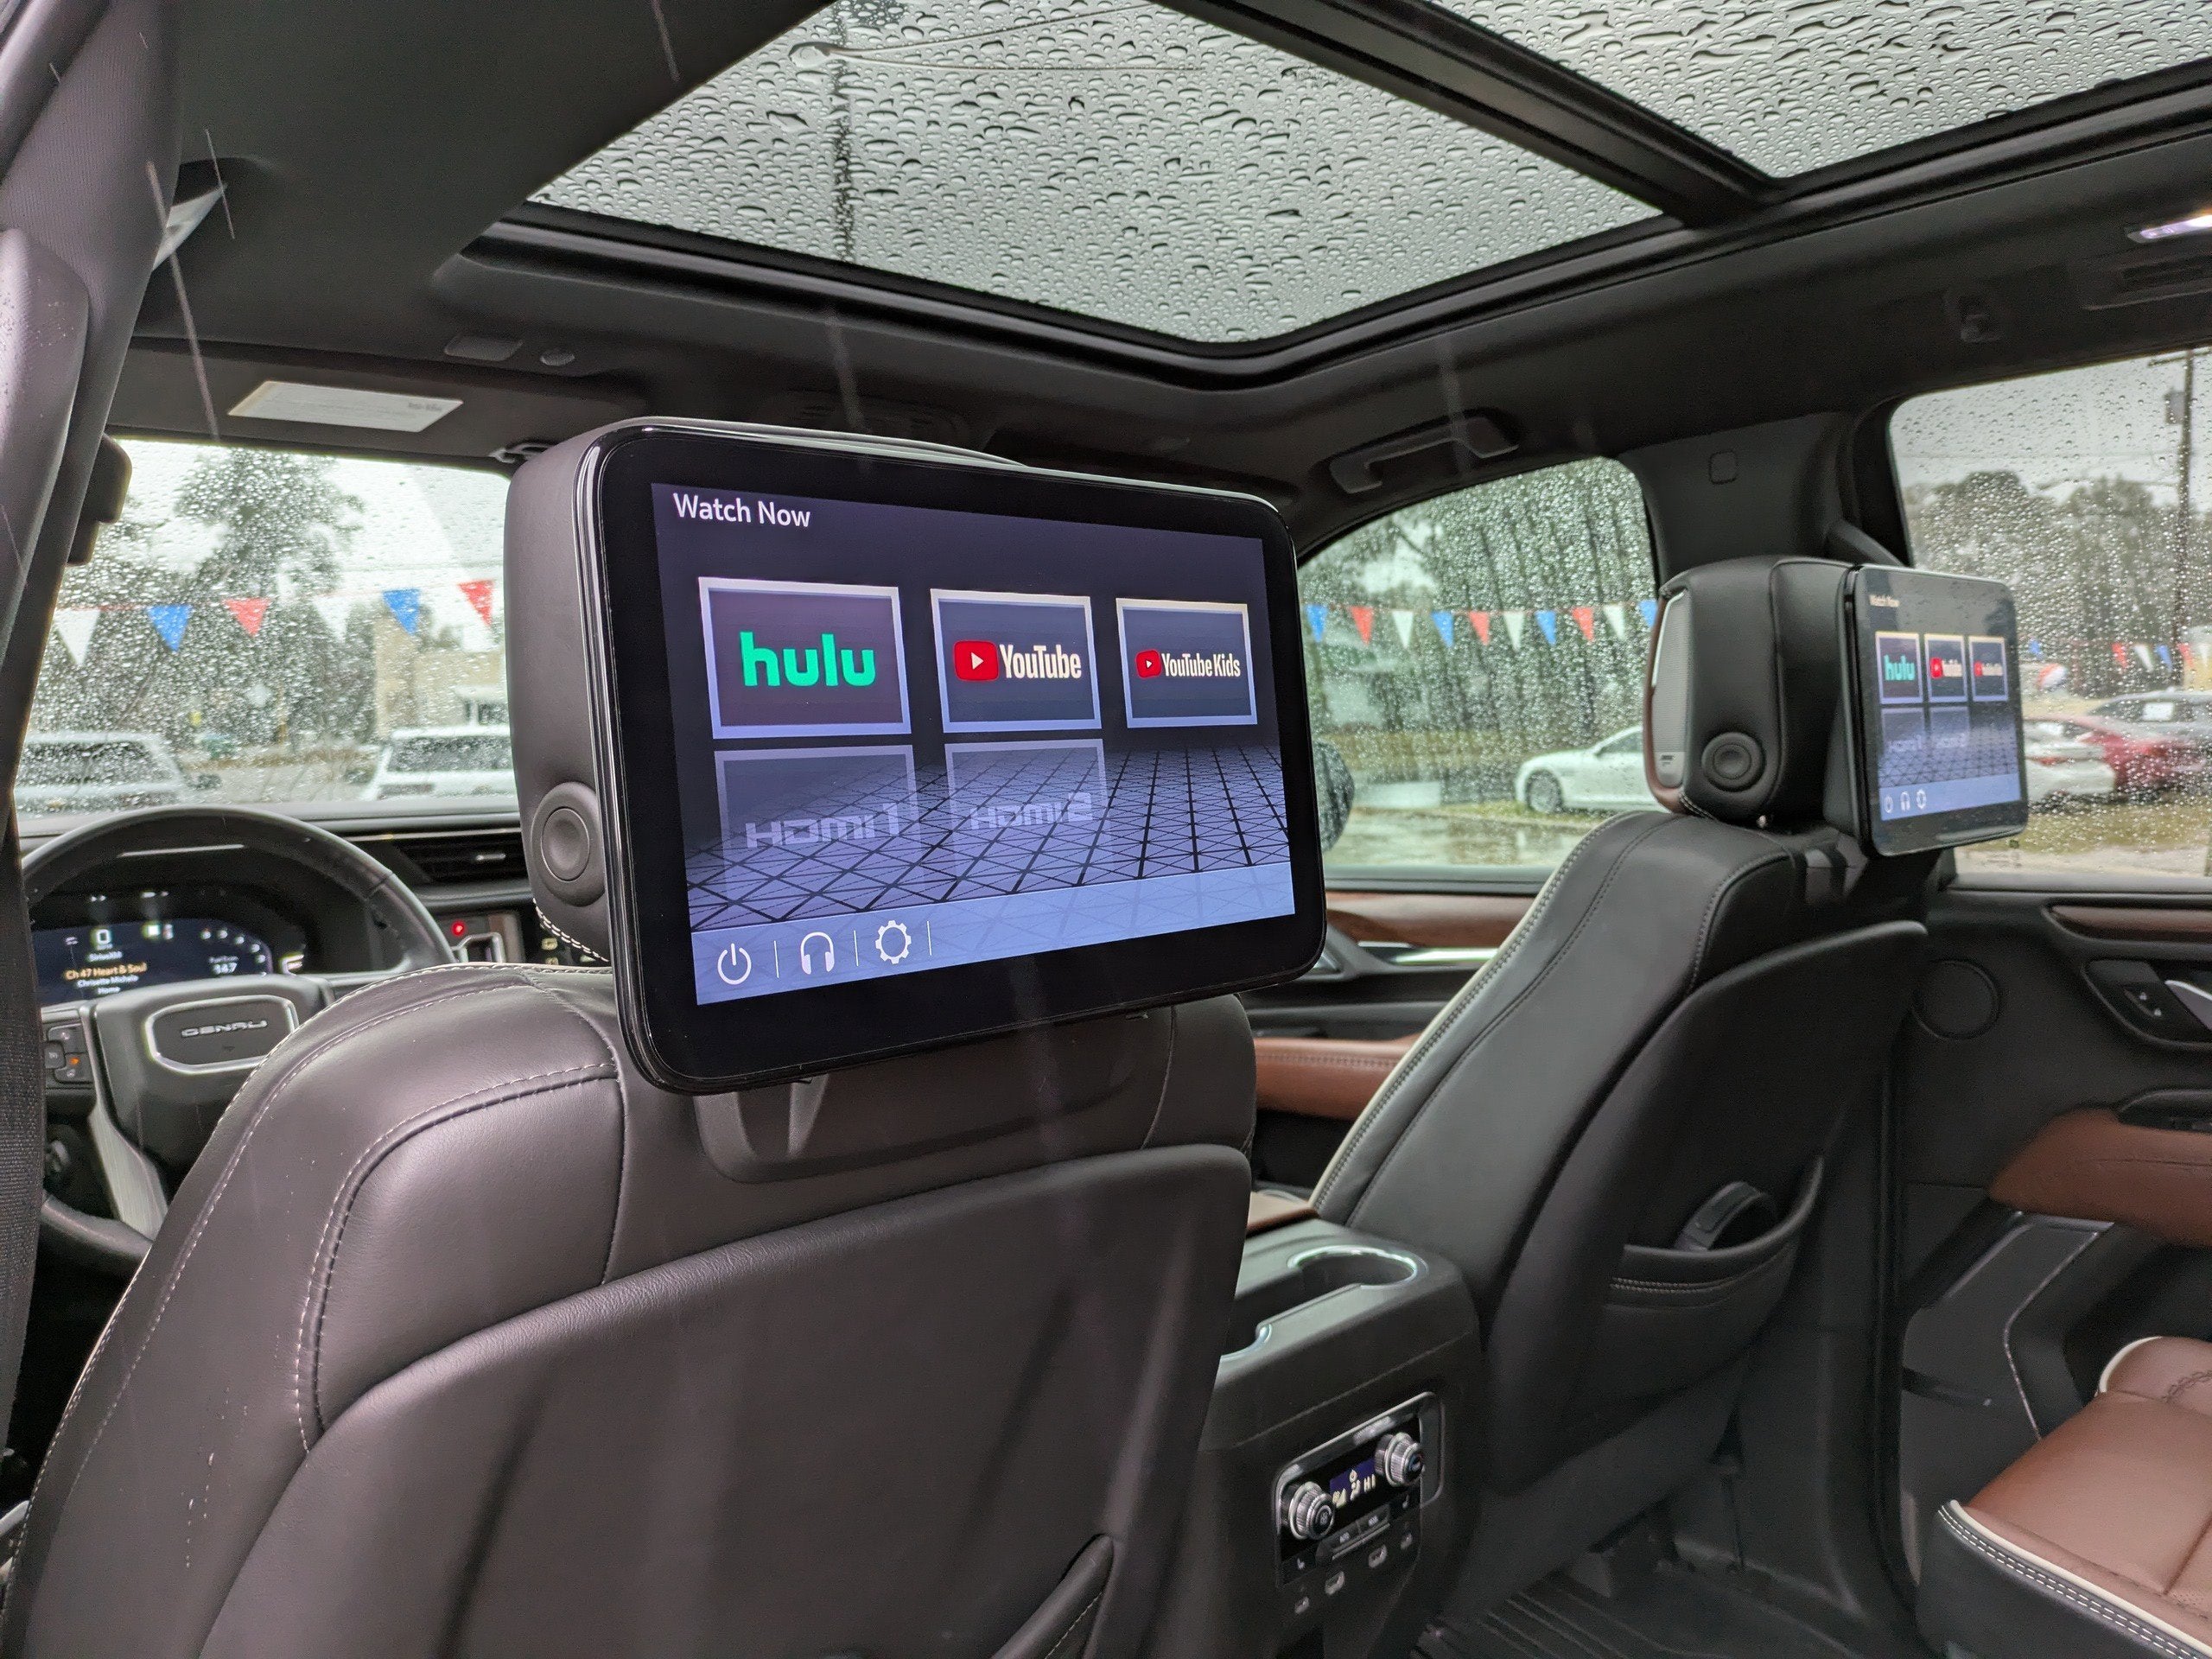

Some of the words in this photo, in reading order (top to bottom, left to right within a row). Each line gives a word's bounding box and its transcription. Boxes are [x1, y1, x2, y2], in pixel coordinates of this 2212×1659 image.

[673, 493, 752, 523] Watch
[758, 500, 810, 527] Now
[740, 631, 876, 686] hulu
[999, 644, 1082, 678] YouTube
[1160, 652, 1213, 677] YouTube
[1213, 652, 1241, 677] Kids
[1884, 654, 1915, 681] hulu
[181, 1020, 268, 1037] DENALI
